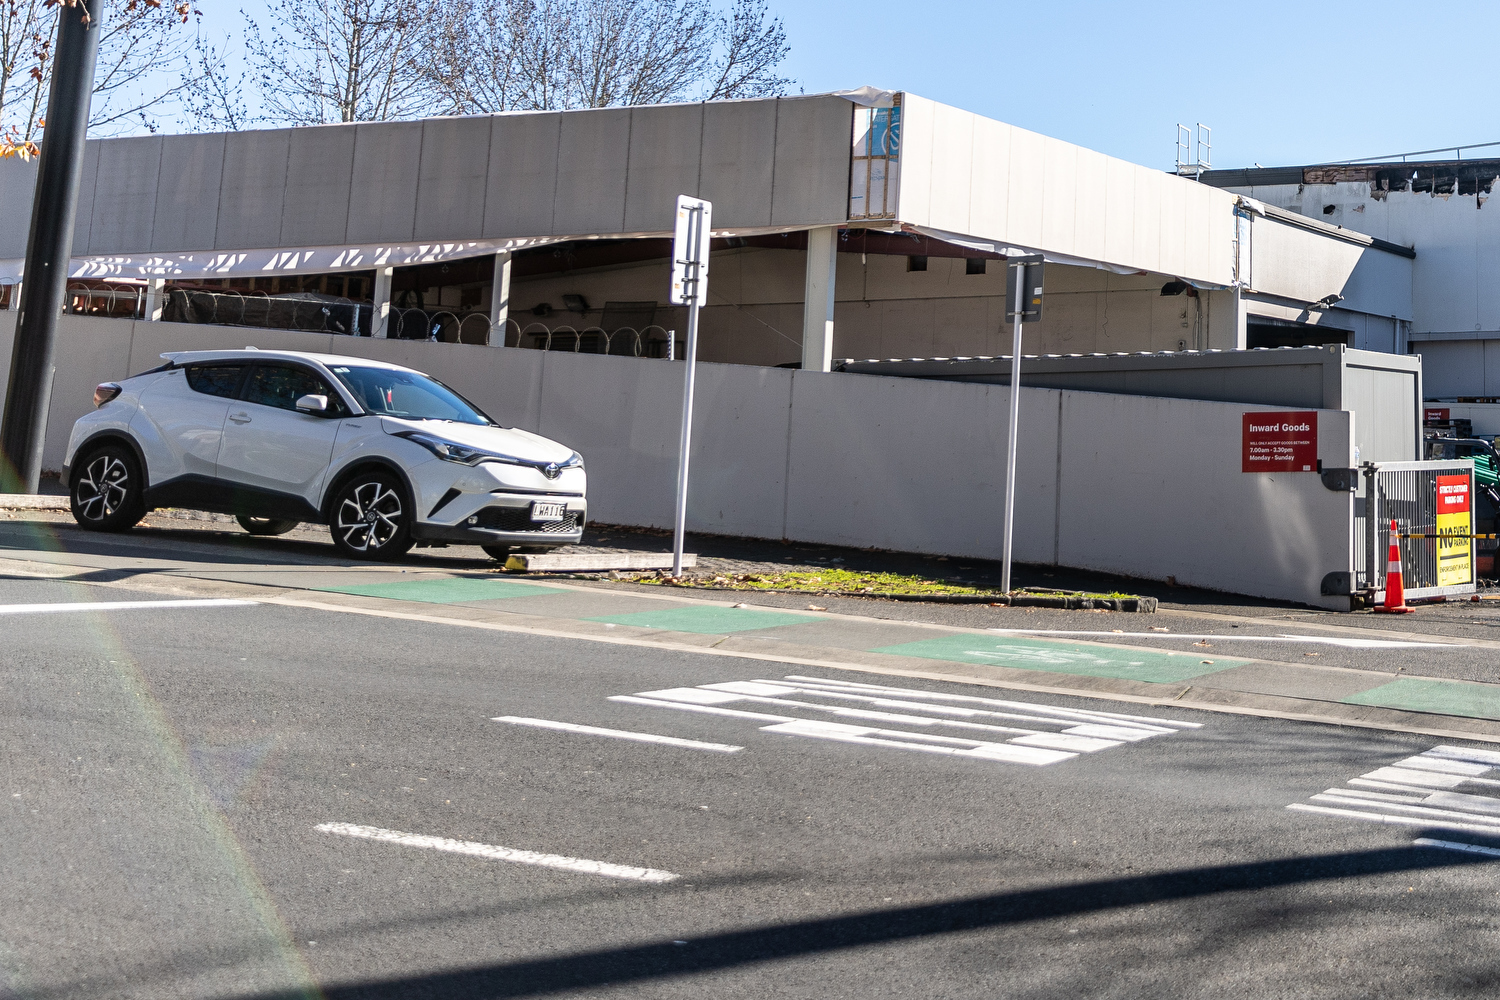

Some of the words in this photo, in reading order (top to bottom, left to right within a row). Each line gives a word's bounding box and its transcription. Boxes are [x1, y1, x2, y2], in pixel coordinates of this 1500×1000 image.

[1250, 423, 1279, 432] Inward
[1282, 423, 1310, 431] Goods
[1440, 527, 1453, 549] NO
[1454, 525, 1468, 536] EVENT
[1454, 538, 1468, 547] PARKING
